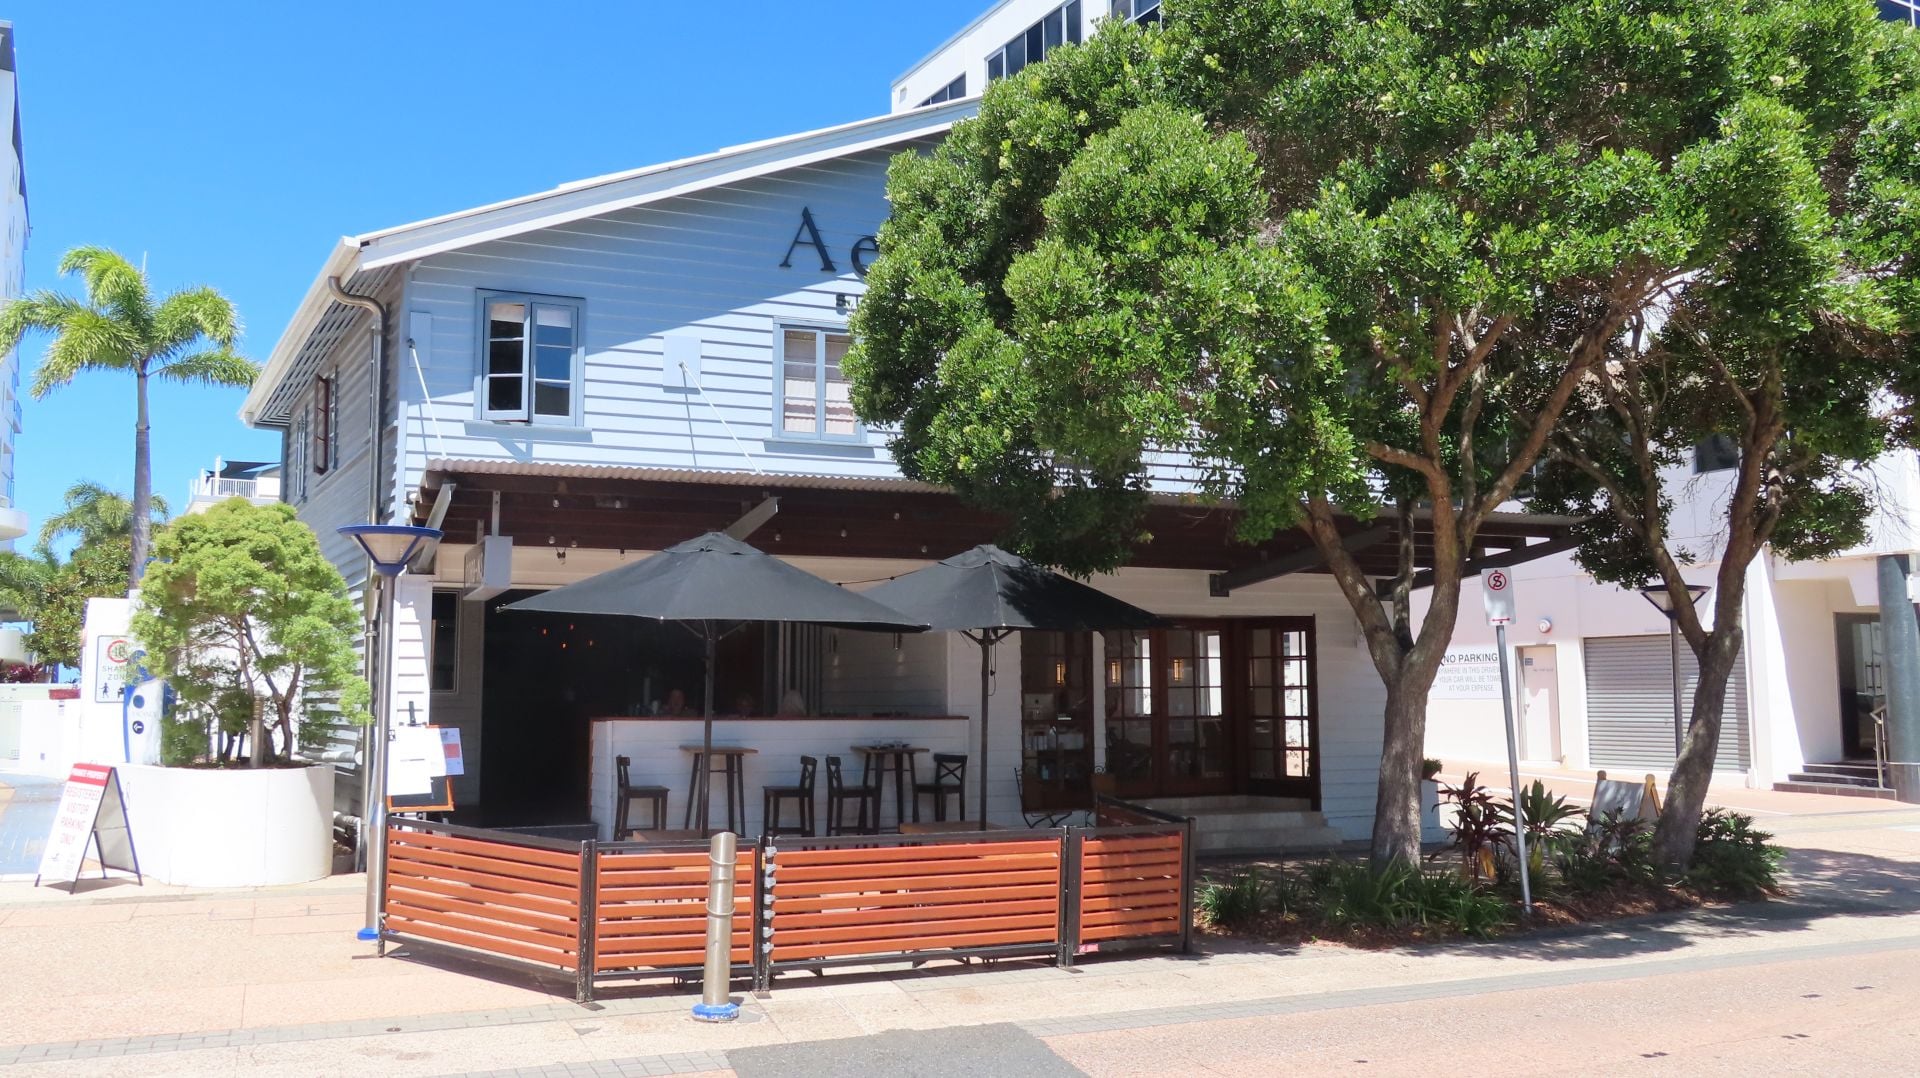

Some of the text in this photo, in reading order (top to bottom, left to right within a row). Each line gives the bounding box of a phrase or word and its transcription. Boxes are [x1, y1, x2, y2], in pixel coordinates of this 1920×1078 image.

[779, 206, 880, 277] Ae
[1443, 652, 1498, 664] NO PARKING
[1487, 674, 1501, 683] TOWE
[1456, 684, 1470, 692] YOUR
[66, 802, 90, 815] VISITOR
[61, 816, 86, 832] PARKING
